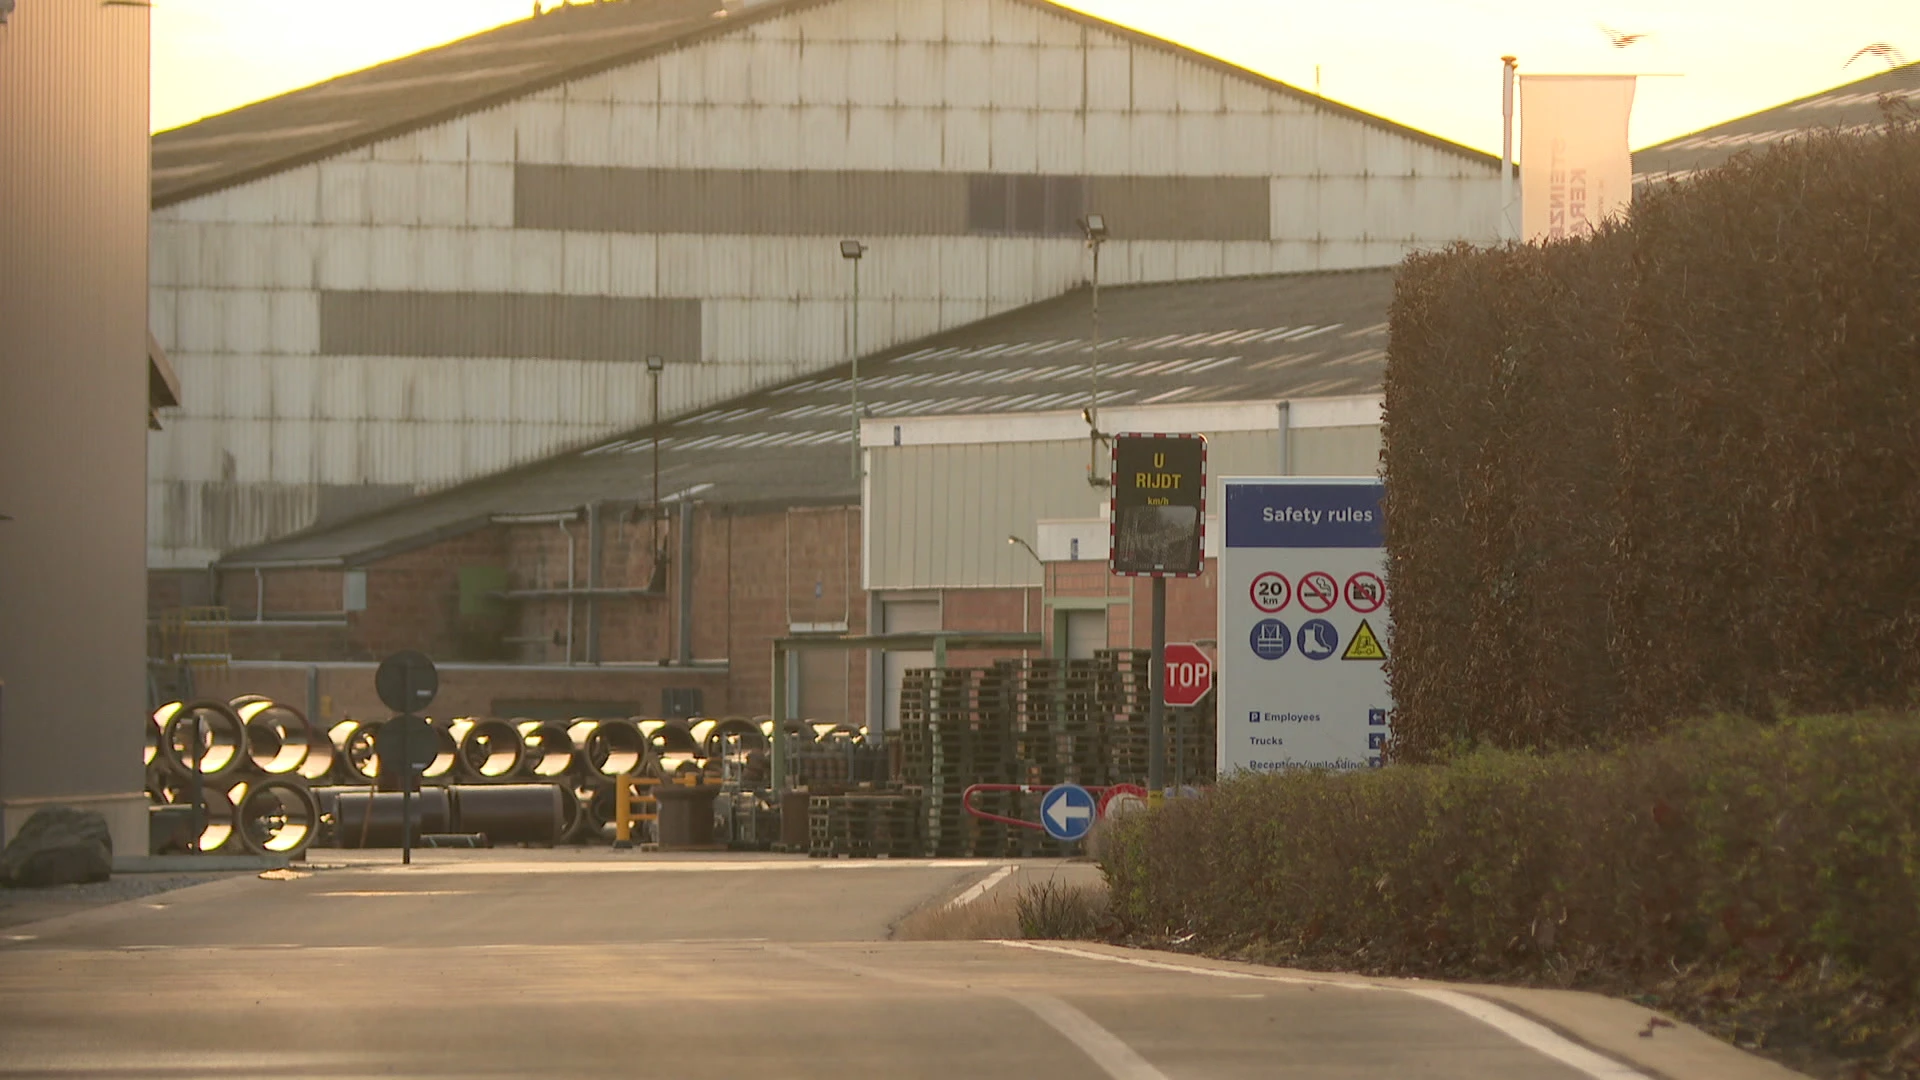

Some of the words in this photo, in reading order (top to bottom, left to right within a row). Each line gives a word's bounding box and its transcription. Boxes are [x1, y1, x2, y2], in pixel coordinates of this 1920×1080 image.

[1154, 453, 1165, 468] U
[1136, 473, 1181, 489] RIJDT
[1147, 497, 1169, 505] km/h
[1263, 507, 1321, 524] Safety
[1328, 507, 1373, 522] rules
[1259, 582, 1282, 596] 20
[1263, 596, 1278, 605] km
[1166, 663, 1208, 687] TOP
[1251, 711, 1259, 722] P
[1264, 712, 1320, 723] Employees
[1250, 736, 1283, 745] Trucks
